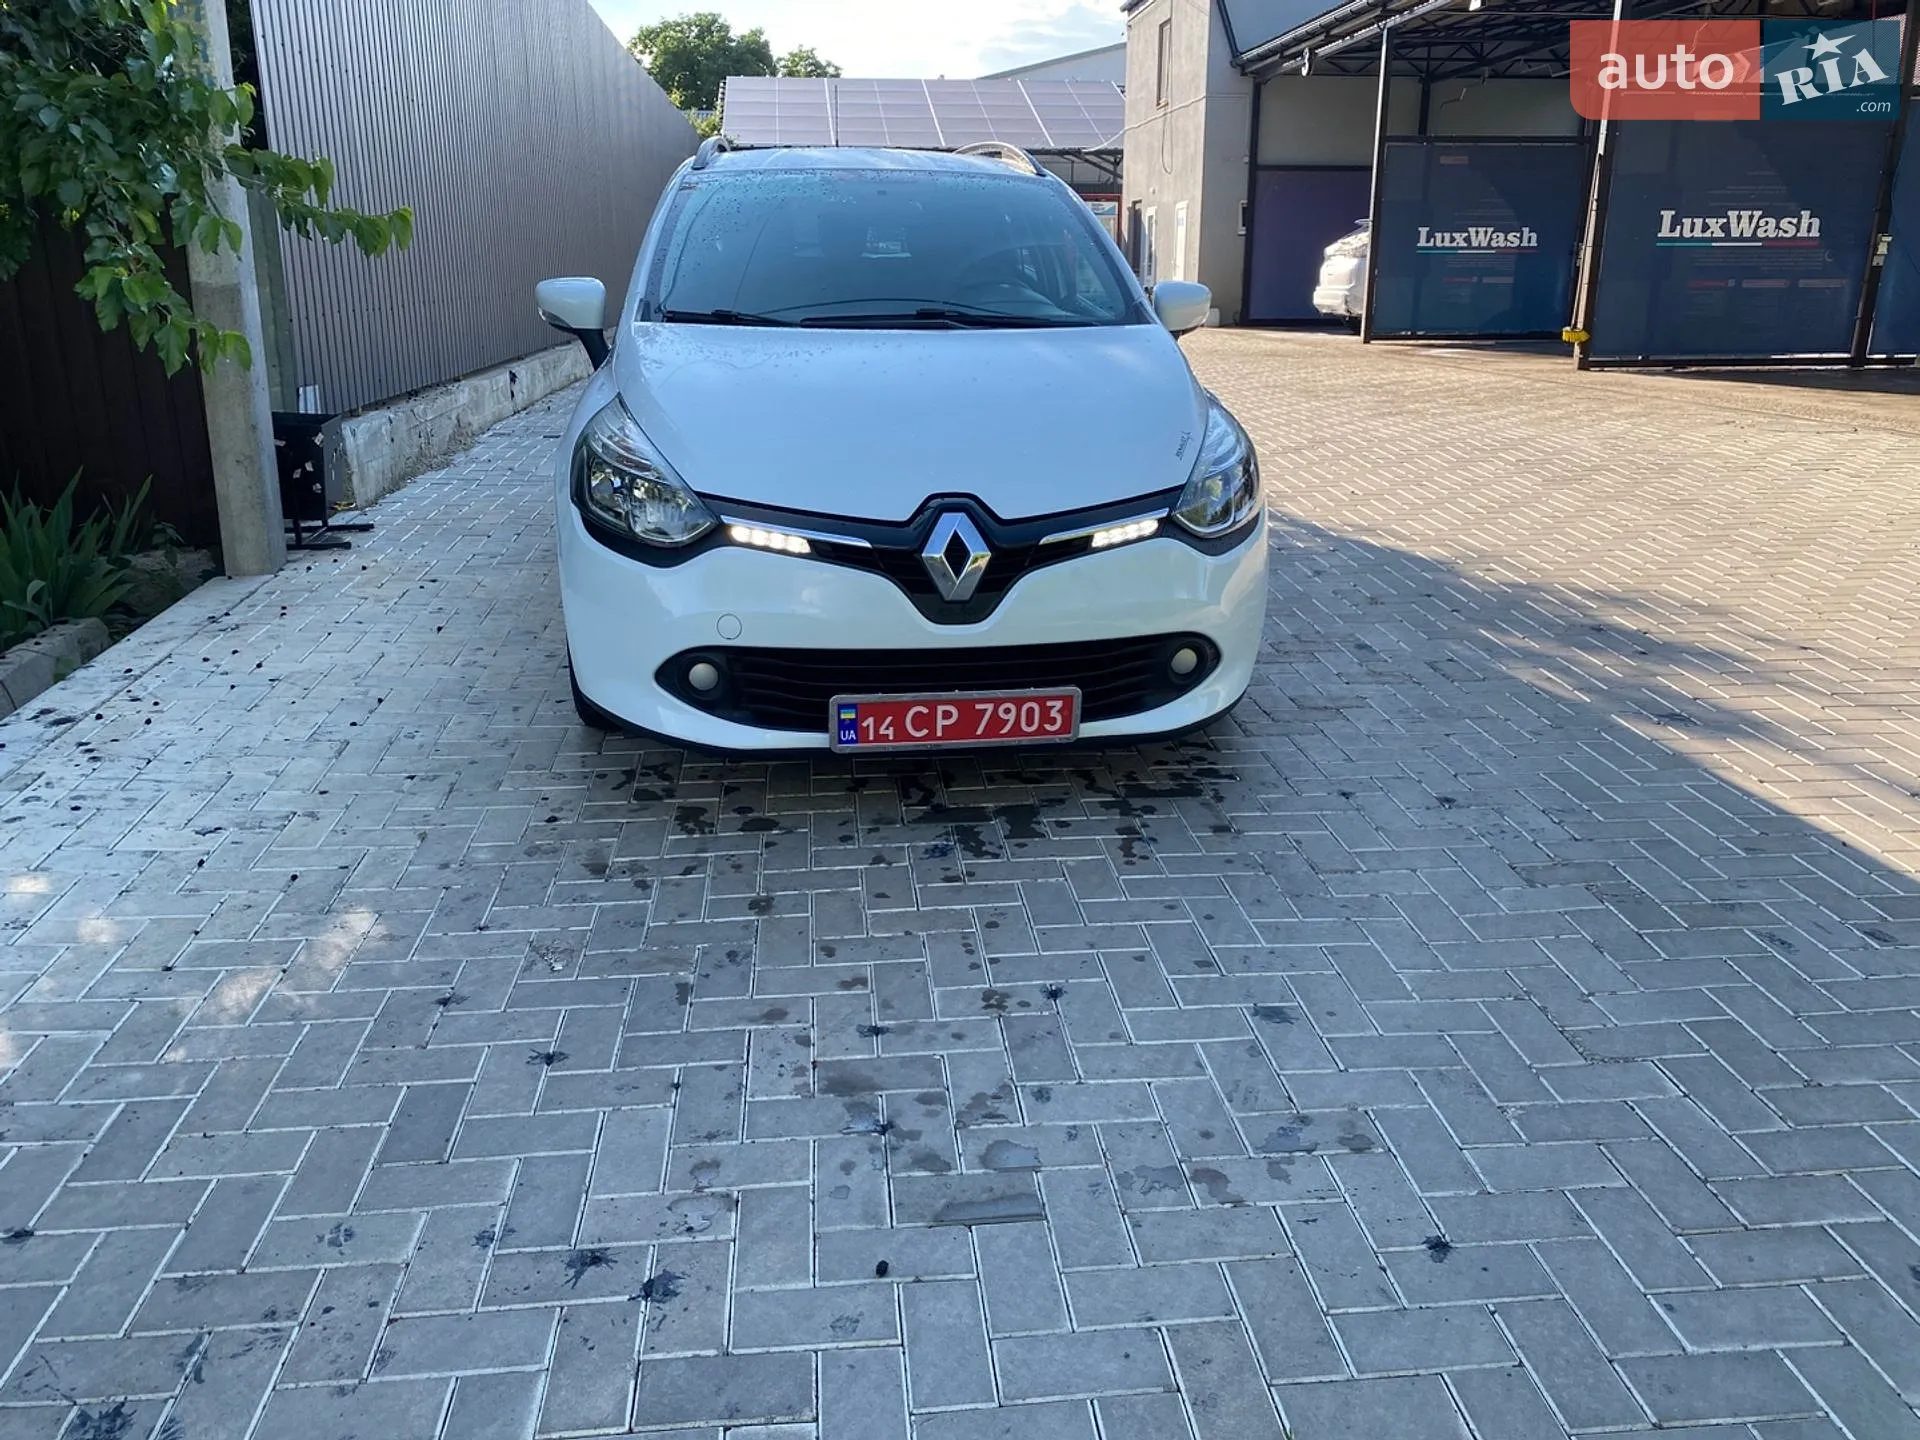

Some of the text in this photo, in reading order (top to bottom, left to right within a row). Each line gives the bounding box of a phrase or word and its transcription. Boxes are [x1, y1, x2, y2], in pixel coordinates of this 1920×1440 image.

[1657, 210, 1821, 238] LuxWash
[1416, 226, 1538, 248] LuxWash
[861, 700, 1064, 740] 14 CP 7903
[840, 730, 856, 741] UA
